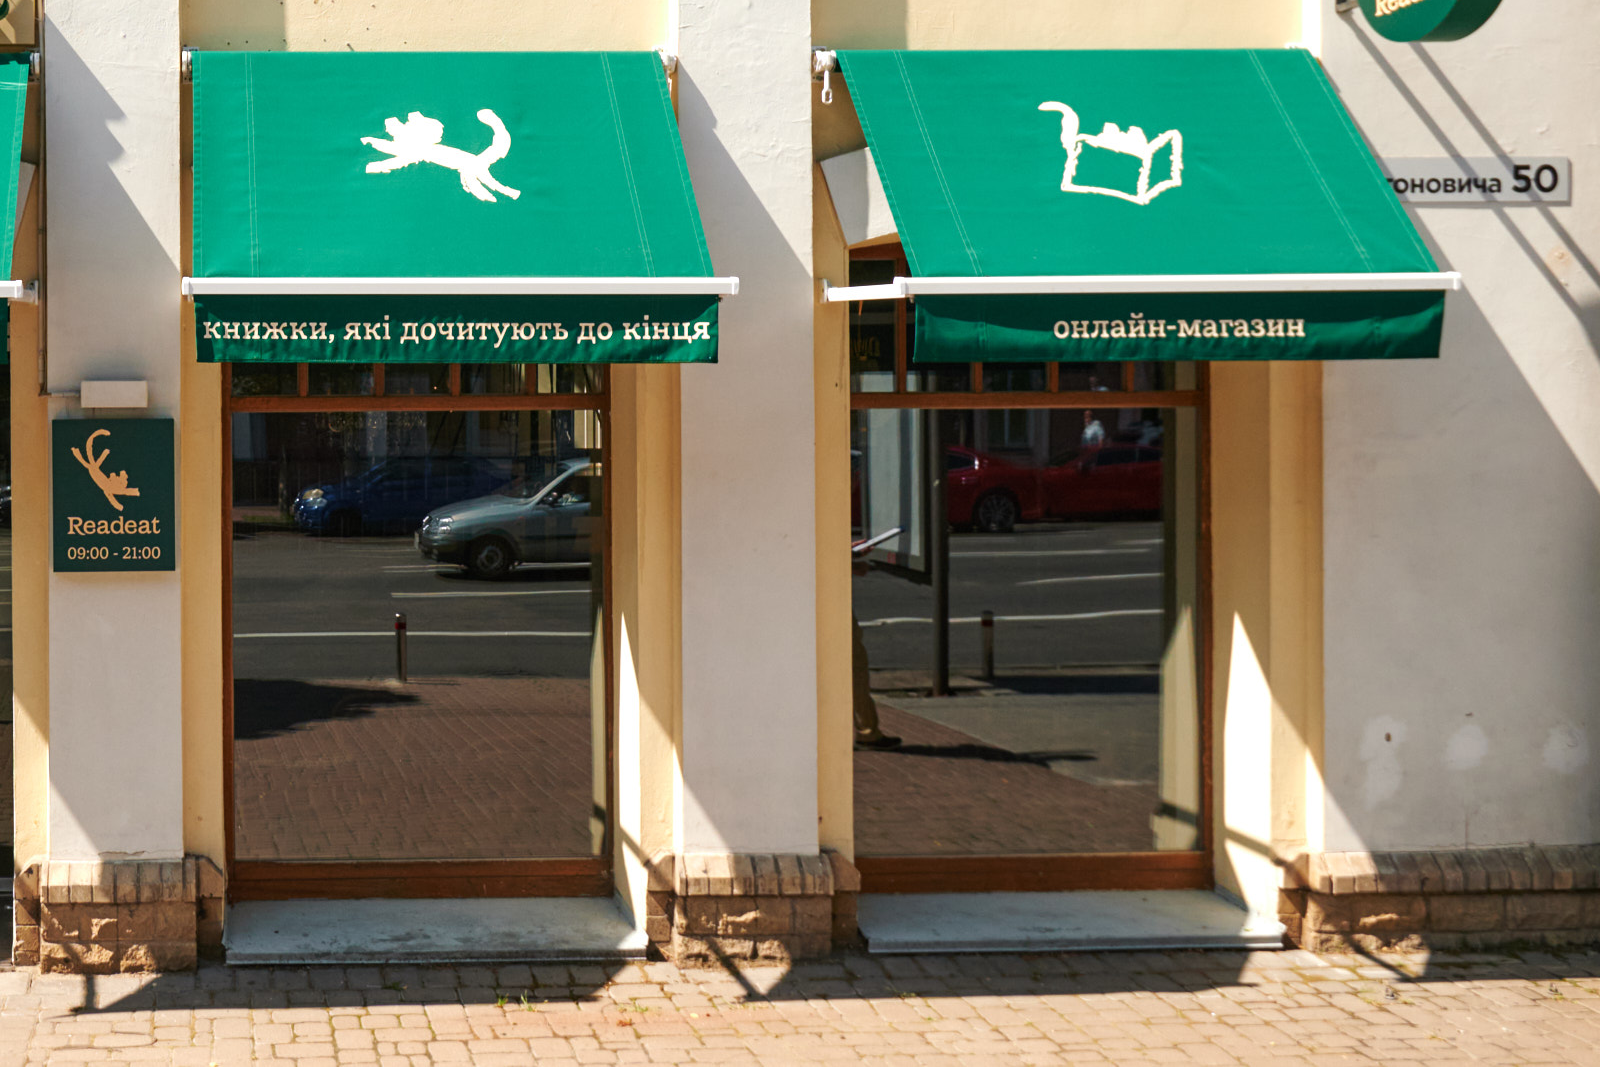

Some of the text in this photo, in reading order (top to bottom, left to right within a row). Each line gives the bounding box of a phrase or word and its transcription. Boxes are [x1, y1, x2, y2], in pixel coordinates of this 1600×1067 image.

[1512, 164, 1559, 193] 50
[202, 314, 711, 348] книжки, які дочитують до кінця
[1053, 312, 1306, 339] онлайн-магазин
[67, 516, 161, 536] Readeat
[67, 546, 109, 560] 09:00
[122, 546, 161, 560] 21:00
